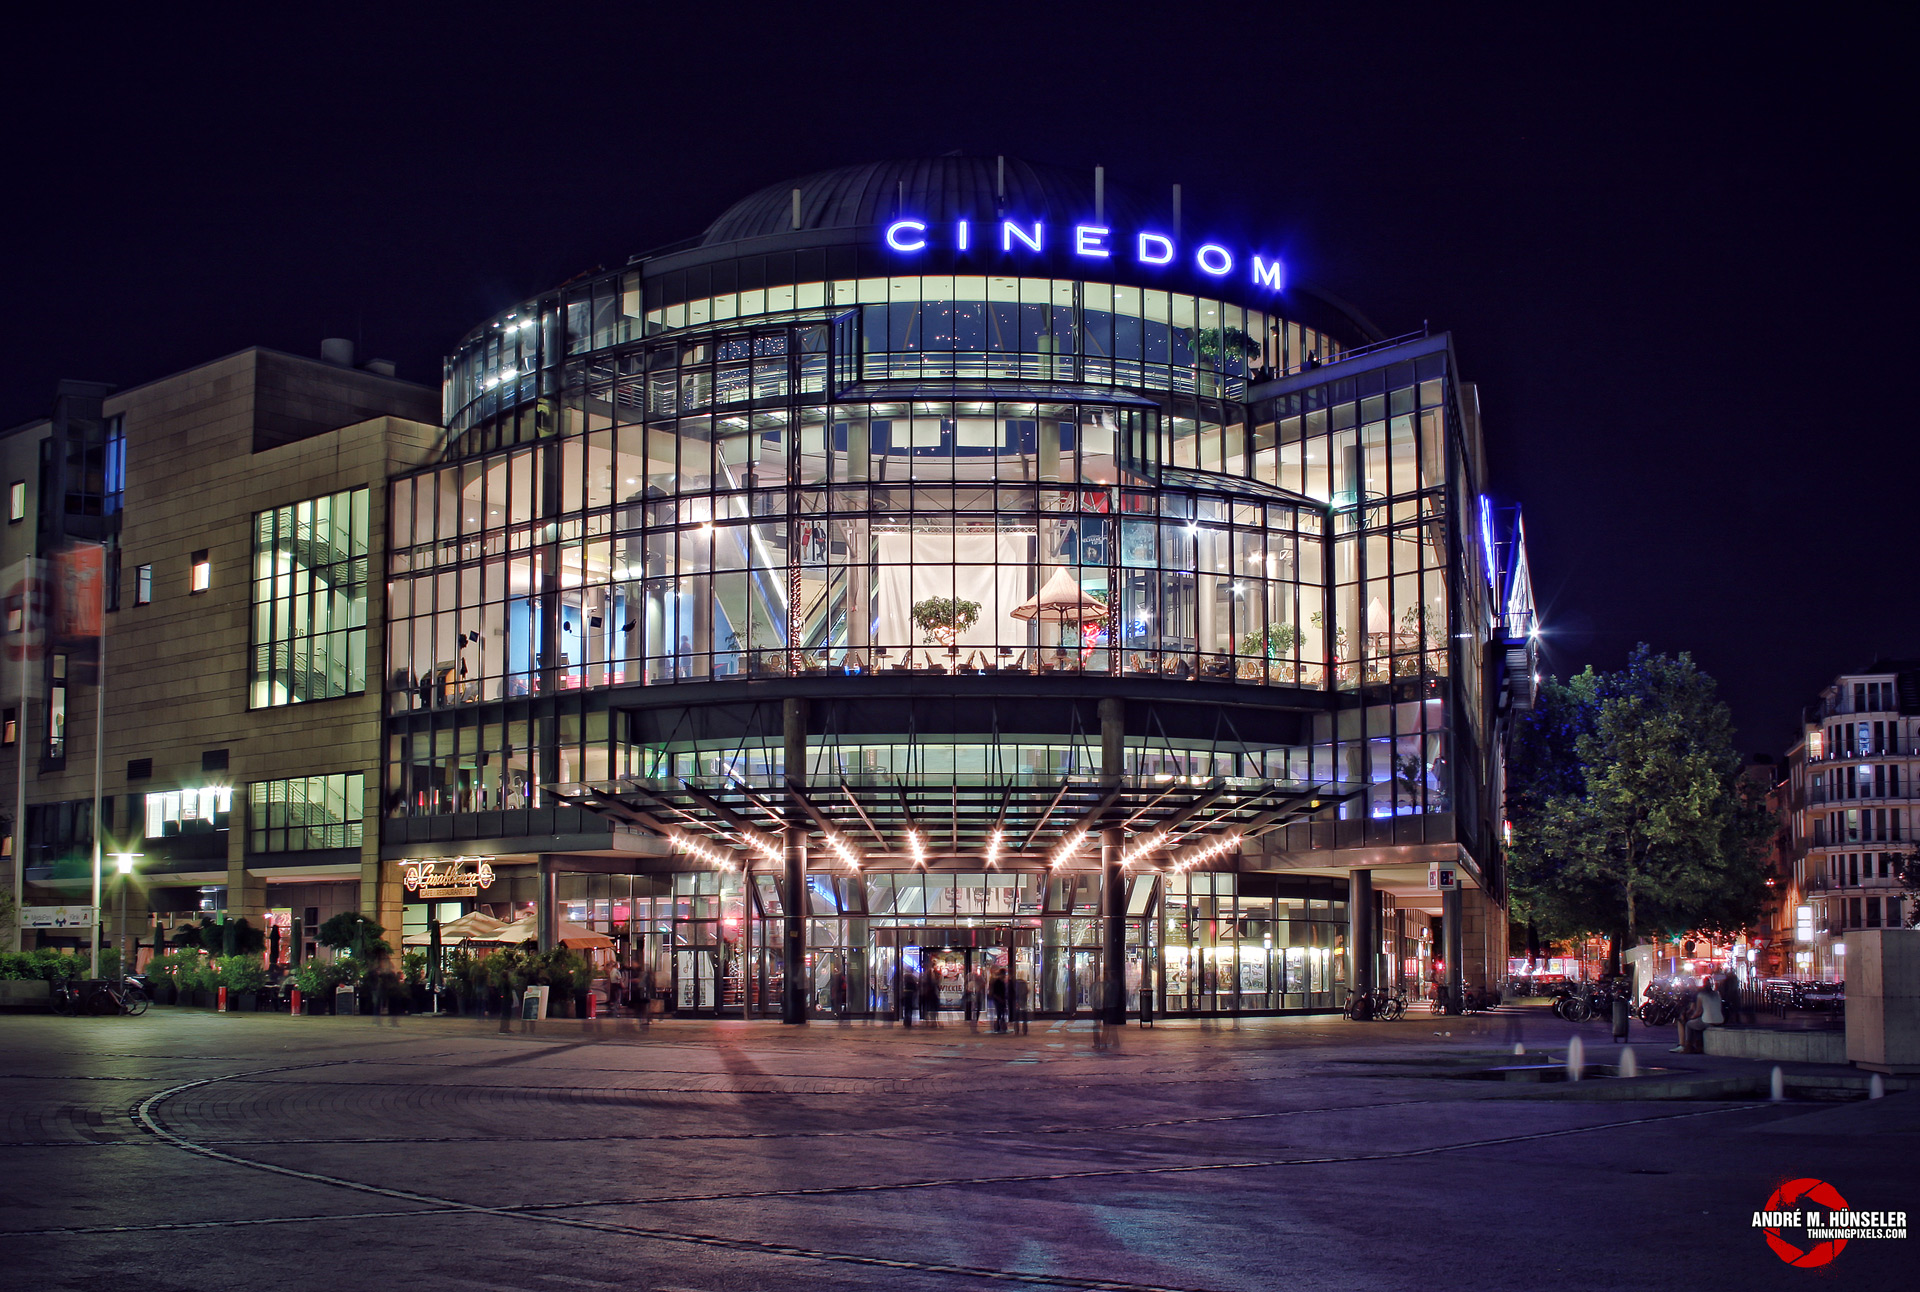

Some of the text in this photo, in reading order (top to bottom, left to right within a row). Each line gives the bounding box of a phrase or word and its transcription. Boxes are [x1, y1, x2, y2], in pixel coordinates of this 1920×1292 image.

[885, 220, 1283, 290] CINEDOM
[437, 888, 463, 896] RESTAURANT
[466, 887, 476, 895] BAR
